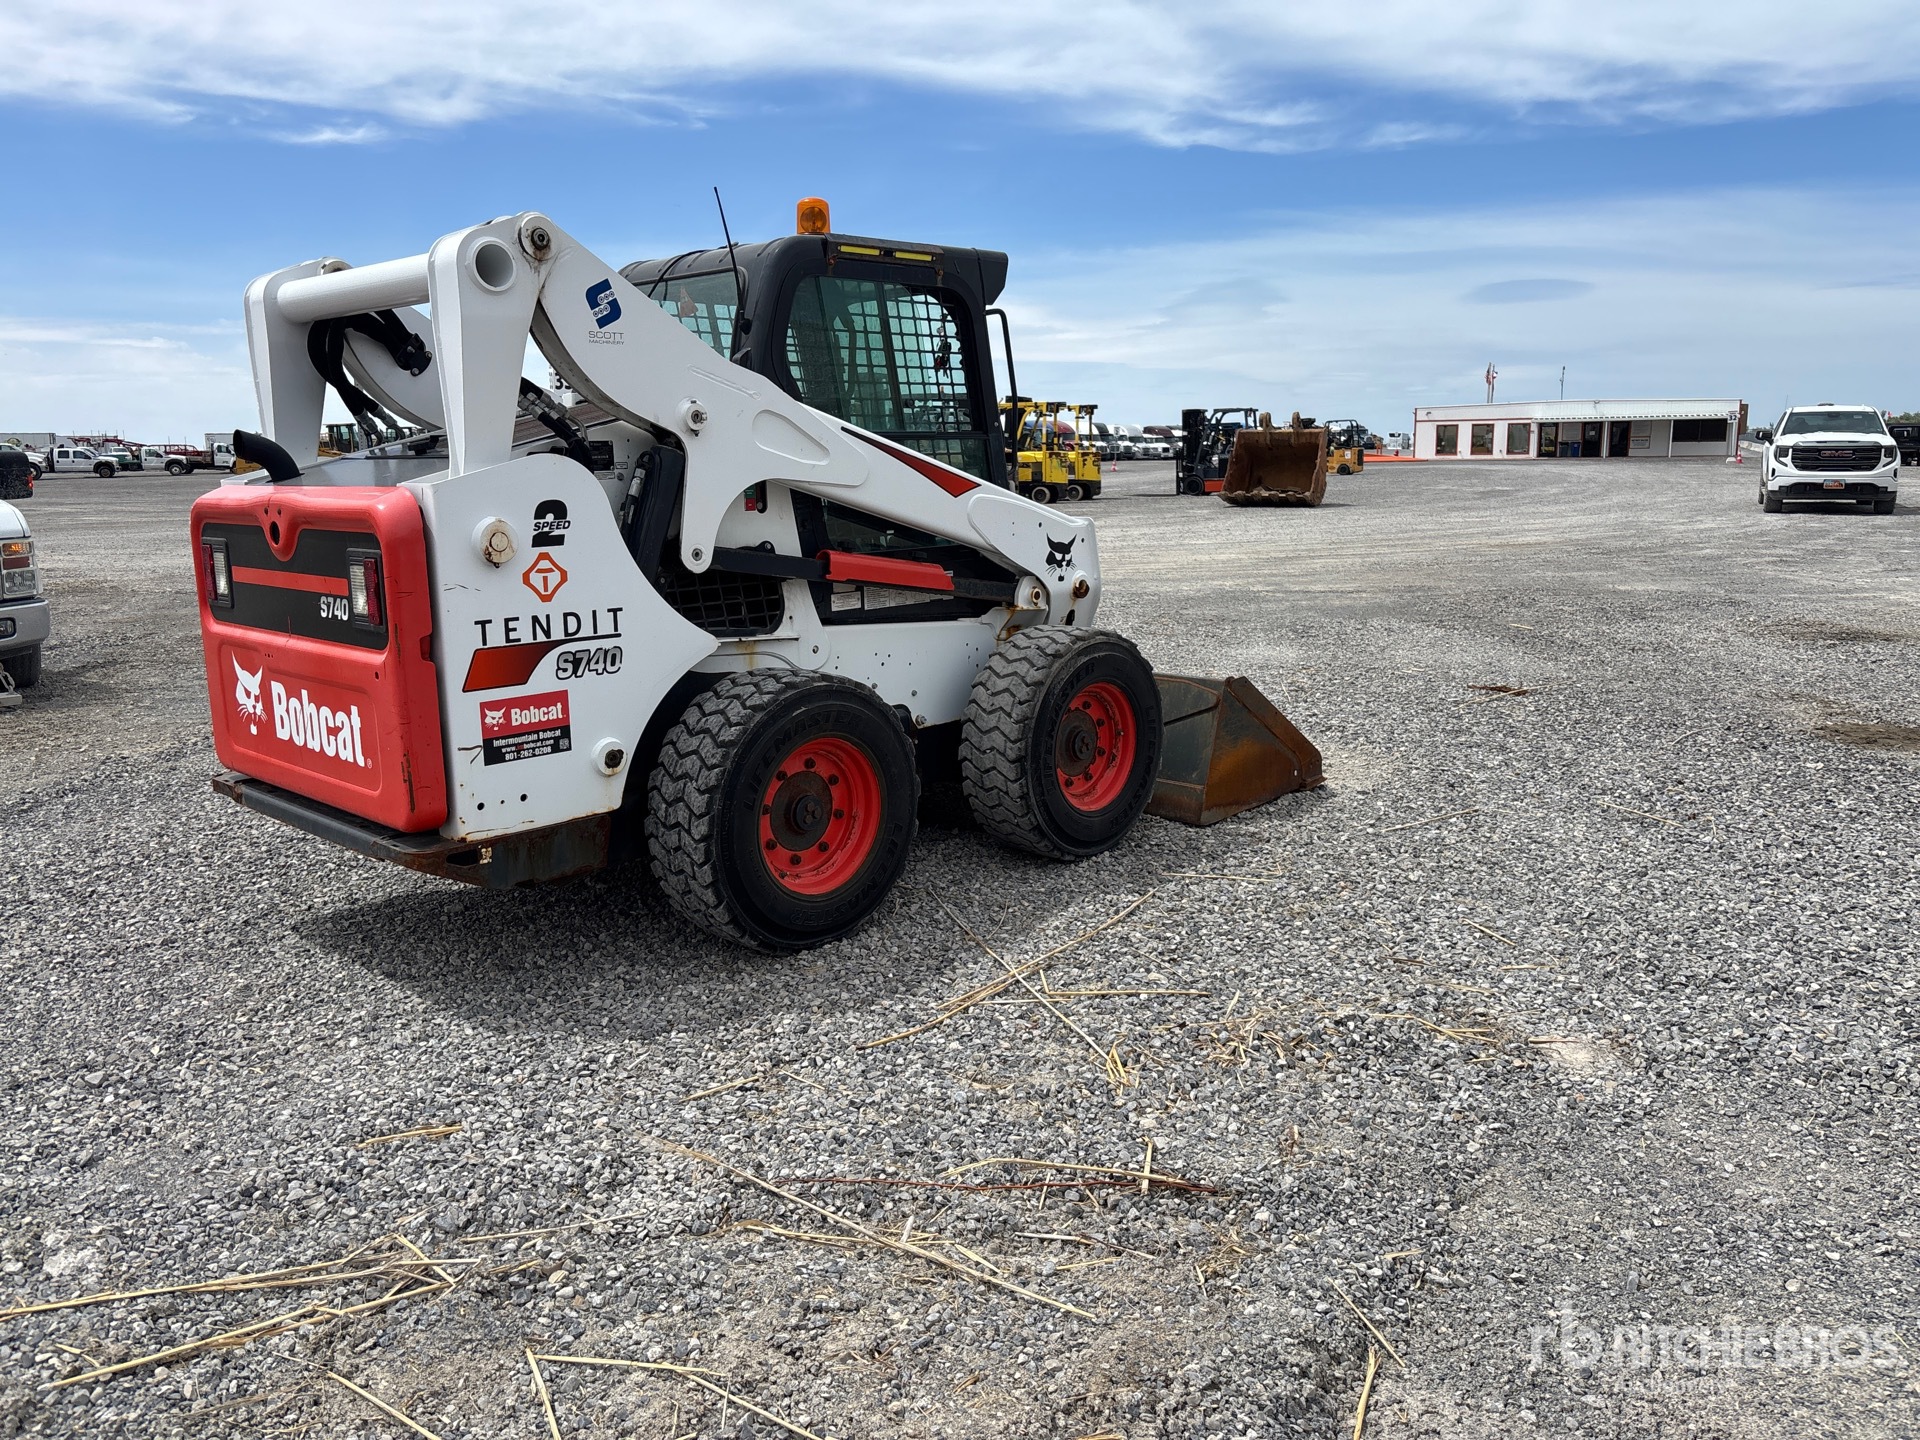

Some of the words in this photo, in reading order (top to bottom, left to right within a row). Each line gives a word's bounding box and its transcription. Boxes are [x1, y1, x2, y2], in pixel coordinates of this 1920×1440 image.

[588, 330, 625, 341] SCOTT
[555, 372, 572, 390] 3
[531, 499, 569, 548] 2
[533, 519, 572, 532] SPEED
[319, 596, 349, 621] S740
[474, 607, 623, 646] TENDIT
[556, 646, 623, 680] S740
[270, 680, 366, 767] Bobcat
[510, 702, 563, 727] Bobcat
[493, 733, 539, 748] Intermountain
[538, 728, 561, 740] Bobcat
